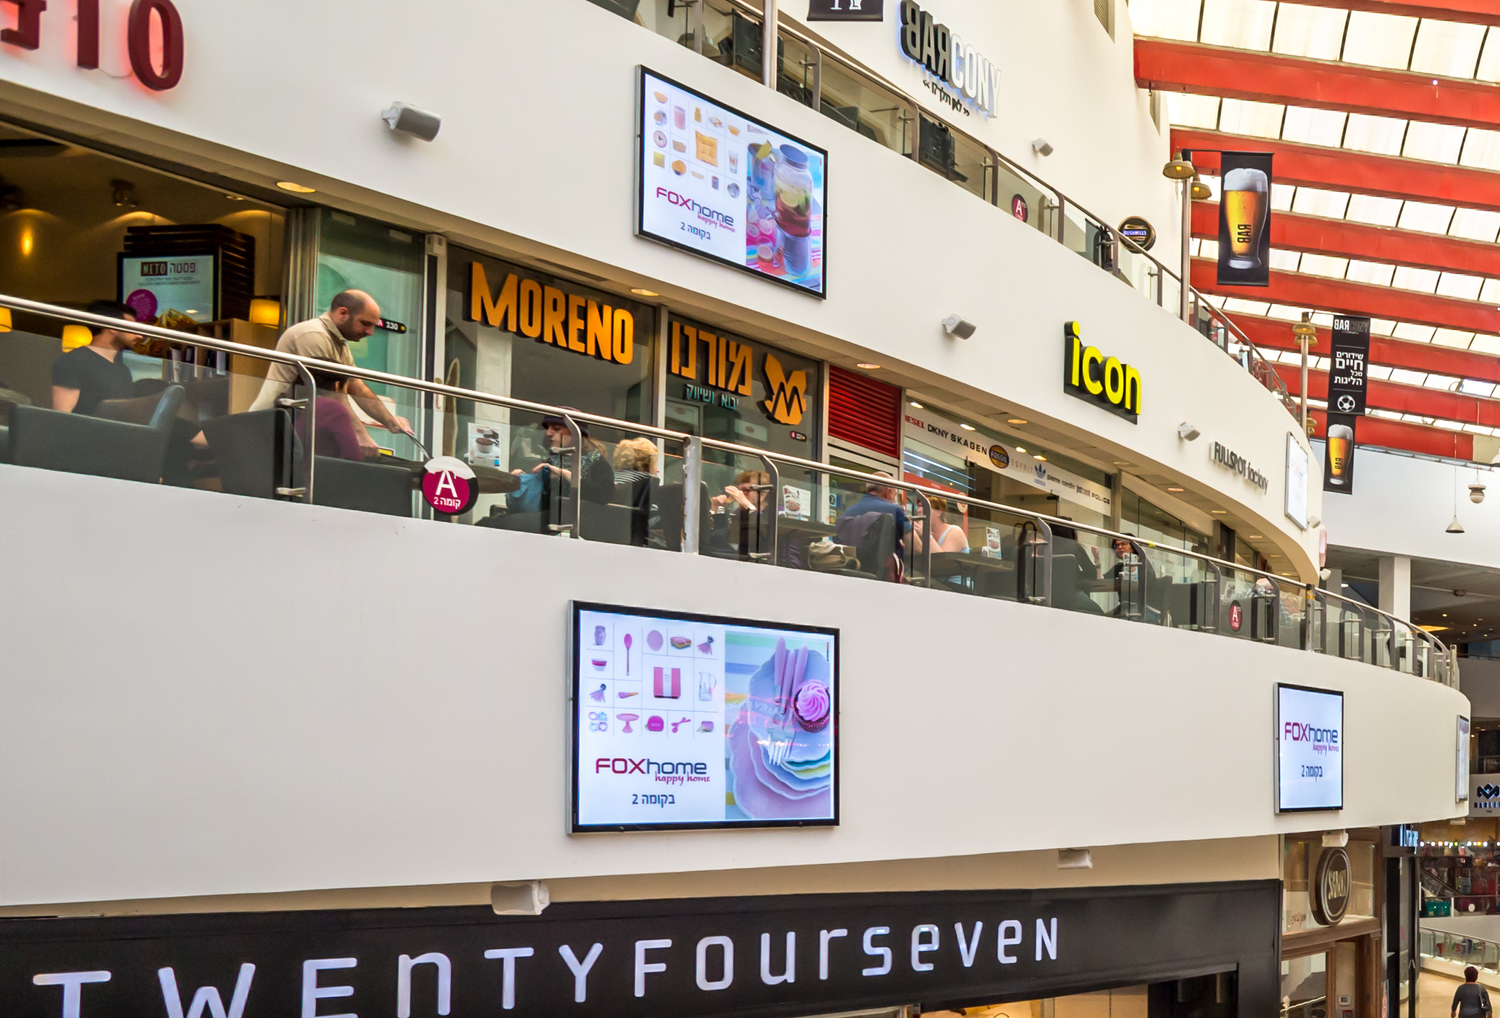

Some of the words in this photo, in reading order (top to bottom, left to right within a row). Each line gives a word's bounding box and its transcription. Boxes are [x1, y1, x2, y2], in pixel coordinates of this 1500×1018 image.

[656, 186, 734, 227] FOXhome
[1015, 199, 1023, 216] A
[680, 222, 686, 231] 2
[687, 224, 711, 240] בקומה
[143, 263, 166, 275] NETO
[471, 261, 634, 365] MORENO
[386, 320, 399, 331] 230
[671, 321, 753, 397] מורנו
[1336, 351, 1364, 360] שידורים
[1071, 321, 1142, 415] icon
[1335, 358, 1364, 371] חיים
[1334, 376, 1363, 386] הליגות
[905, 415, 926, 430] IESEL
[928, 423, 949, 439] DKNY
[951, 433, 988, 456] SKAGEN
[990, 450, 1008, 463] FOSSIL
[1213, 440, 1248, 477] FULLSPOT
[435, 469, 458, 499] A
[433, 497, 439, 505] 2
[439, 497, 461, 510] קומה
[1232, 605, 1239, 622] A
[1284, 721, 1339, 744] FOXhome
[595, 757, 707, 775] FOXhome
[1301, 765, 1306, 777] 2
[654, 770, 684, 787] happy
[686, 770, 711, 783] home
[631, 793, 639, 805] 2
[641, 793, 676, 809] בקומה
